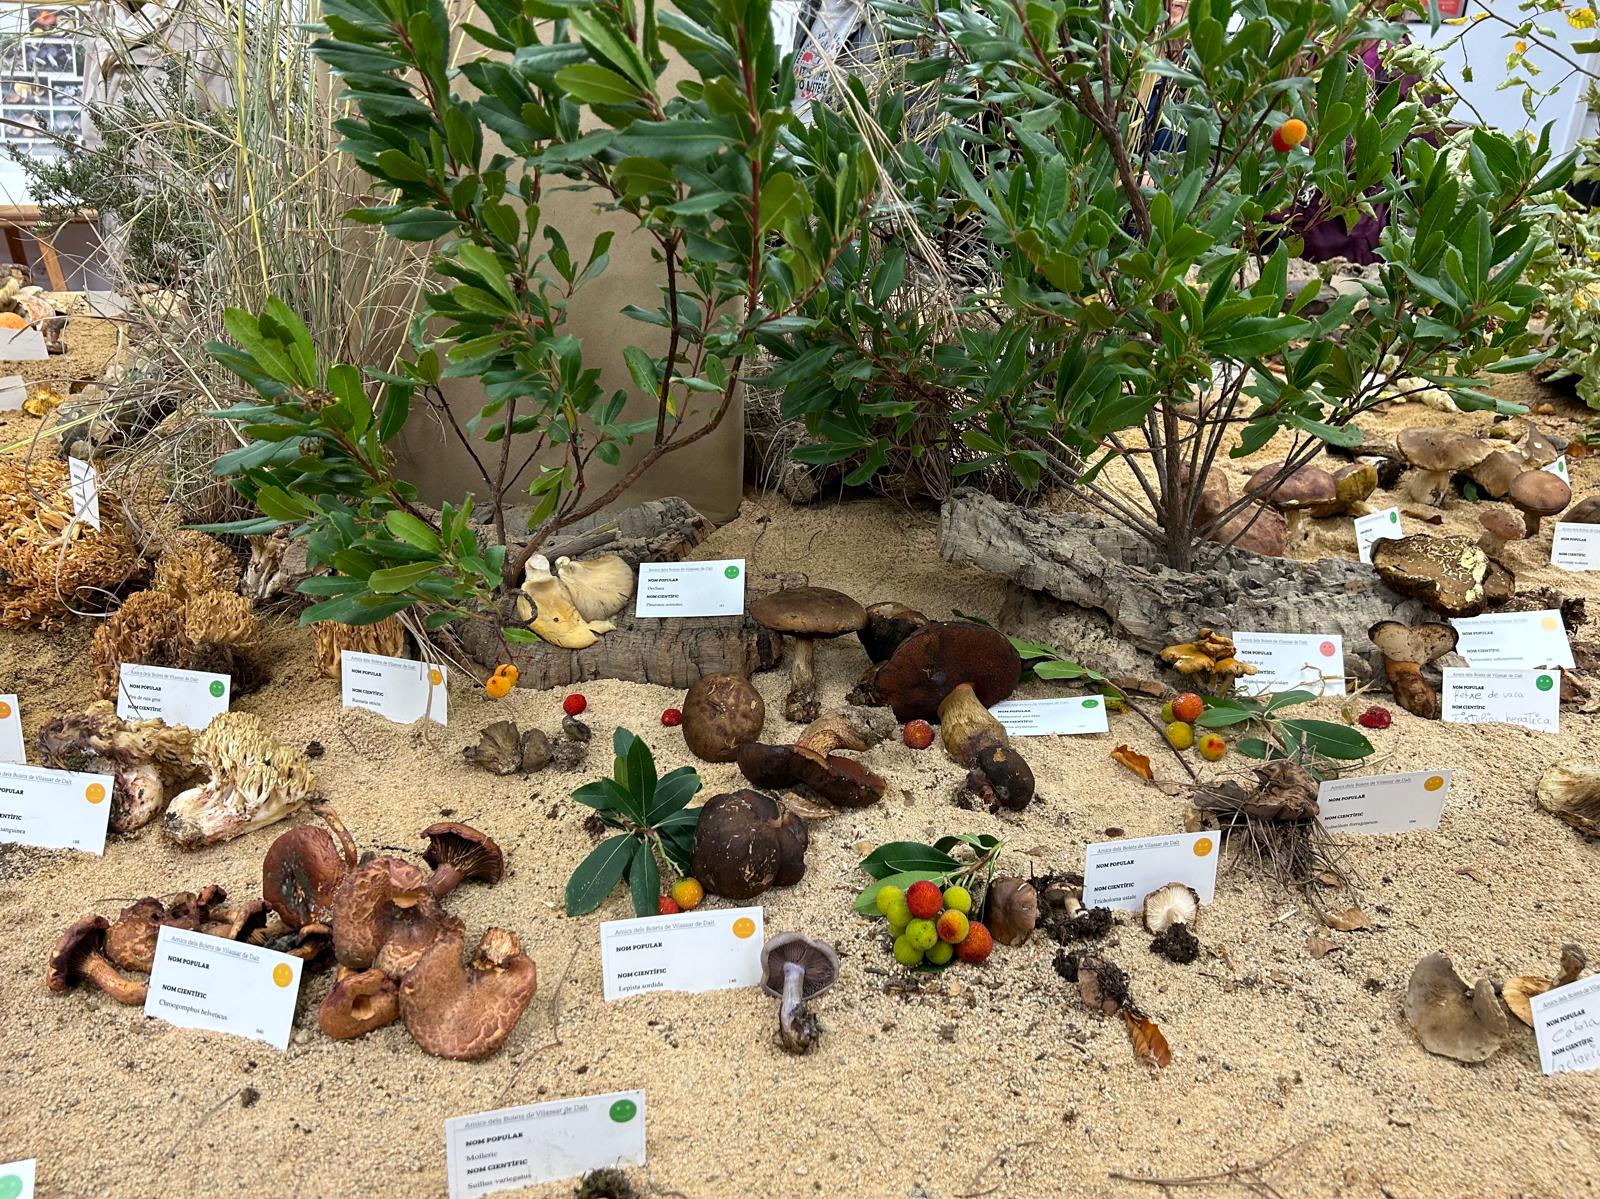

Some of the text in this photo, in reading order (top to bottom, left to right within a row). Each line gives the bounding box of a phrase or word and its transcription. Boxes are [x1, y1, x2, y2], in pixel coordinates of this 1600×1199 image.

[1108, 882, 1134, 890] CIENTÍFIC
[171, 935, 188, 944] Amics
[188, 939, 198, 947] dels
[199, 941, 214, 951] Bolets
[222, 946, 242, 958] Vilassar
[249, 954, 260, 962] Dalt
[632, 942, 662, 950] POPULAR
[168, 955, 210, 970] NOM POPULAR
[618, 968, 667, 979] NOM CIENTÍFIC
[162, 984, 207, 999] NOM CIENTÍFIC
[618, 981, 664, 992] Lepista sordida
[1546, 1008, 1586, 1028] NOM POPULAR
[1552, 1036, 1594, 1057] NOM CIENTÍFIC
[465, 1104, 588, 1129] Amics dels Bolets de Vilassar de Dalt
[466, 1132, 524, 1147] NOM POPULAR
[466, 1150, 498, 1162] Molleric
[467, 1158, 528, 1175] NOM CIENTÍFIC
[468, 1172, 532, 1190] Suillus variegatus
